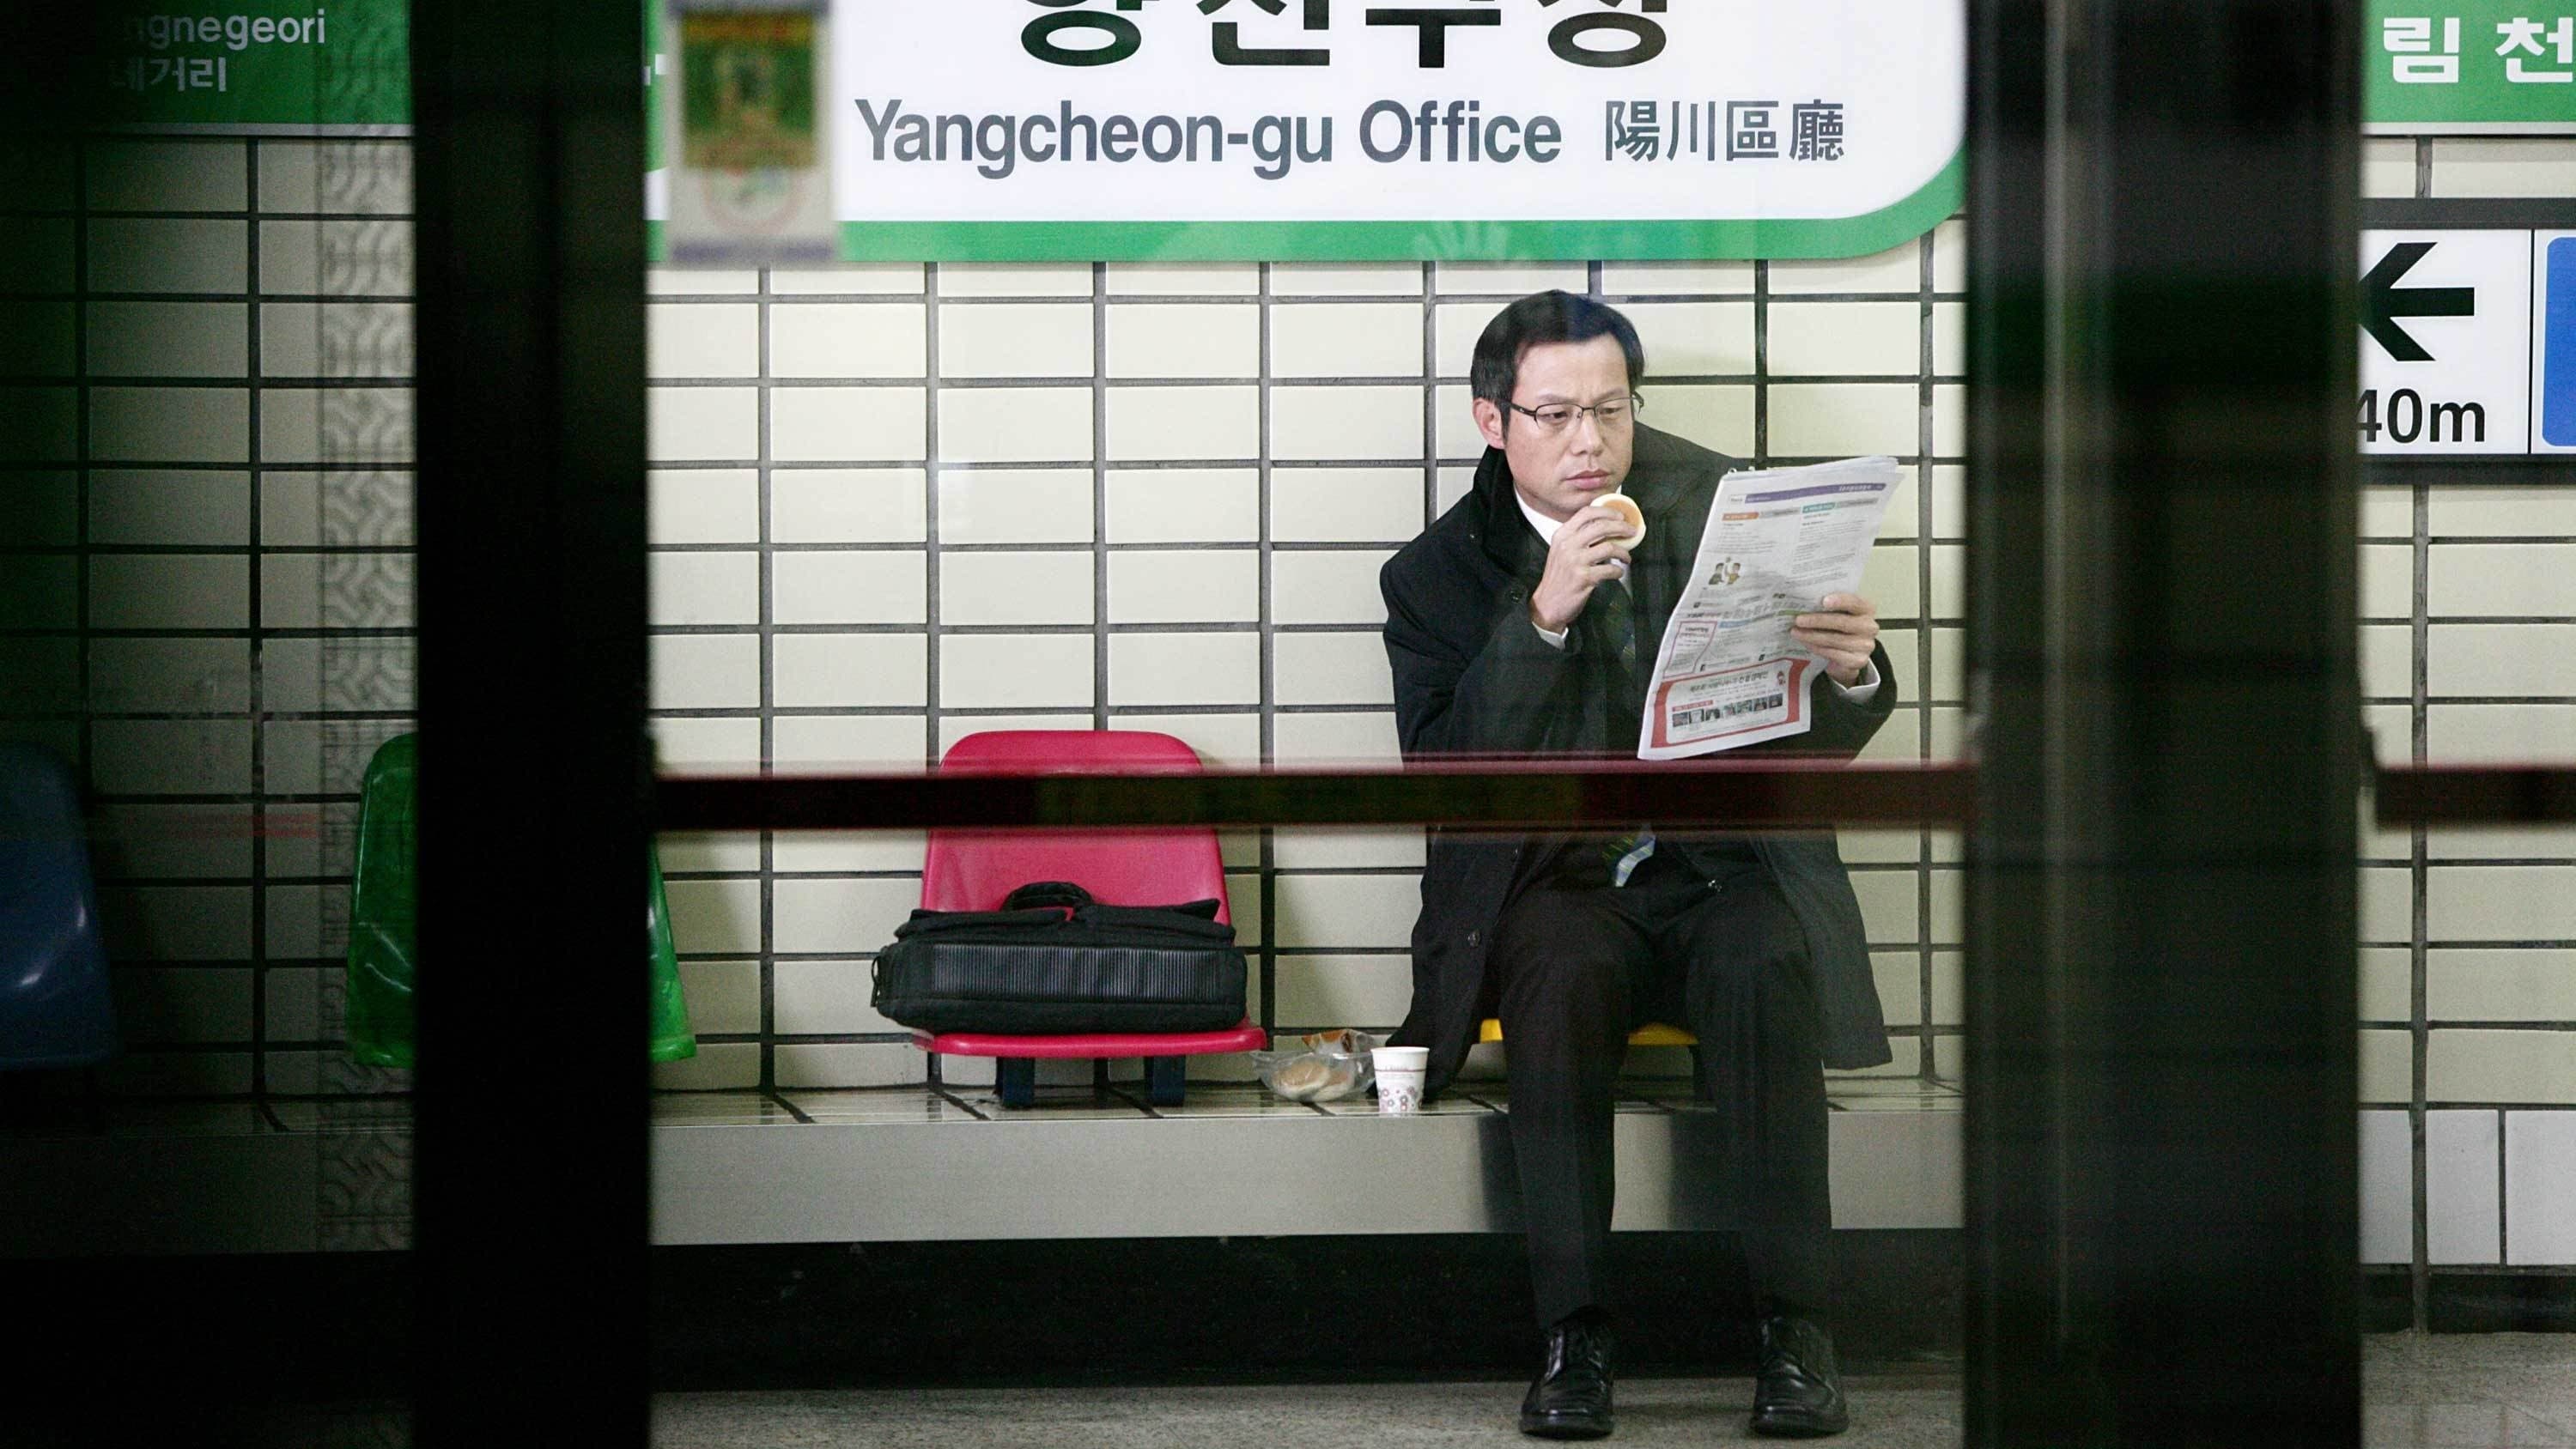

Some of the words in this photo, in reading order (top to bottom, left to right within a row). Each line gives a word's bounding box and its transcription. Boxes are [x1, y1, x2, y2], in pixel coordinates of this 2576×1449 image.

[854, 99, 1333, 180] Yangcheon-gu
[1359, 100, 1562, 163] Office
[1605, 99, 1844, 162] 陽川區廳
[2357, 387, 2486, 444] 40m
